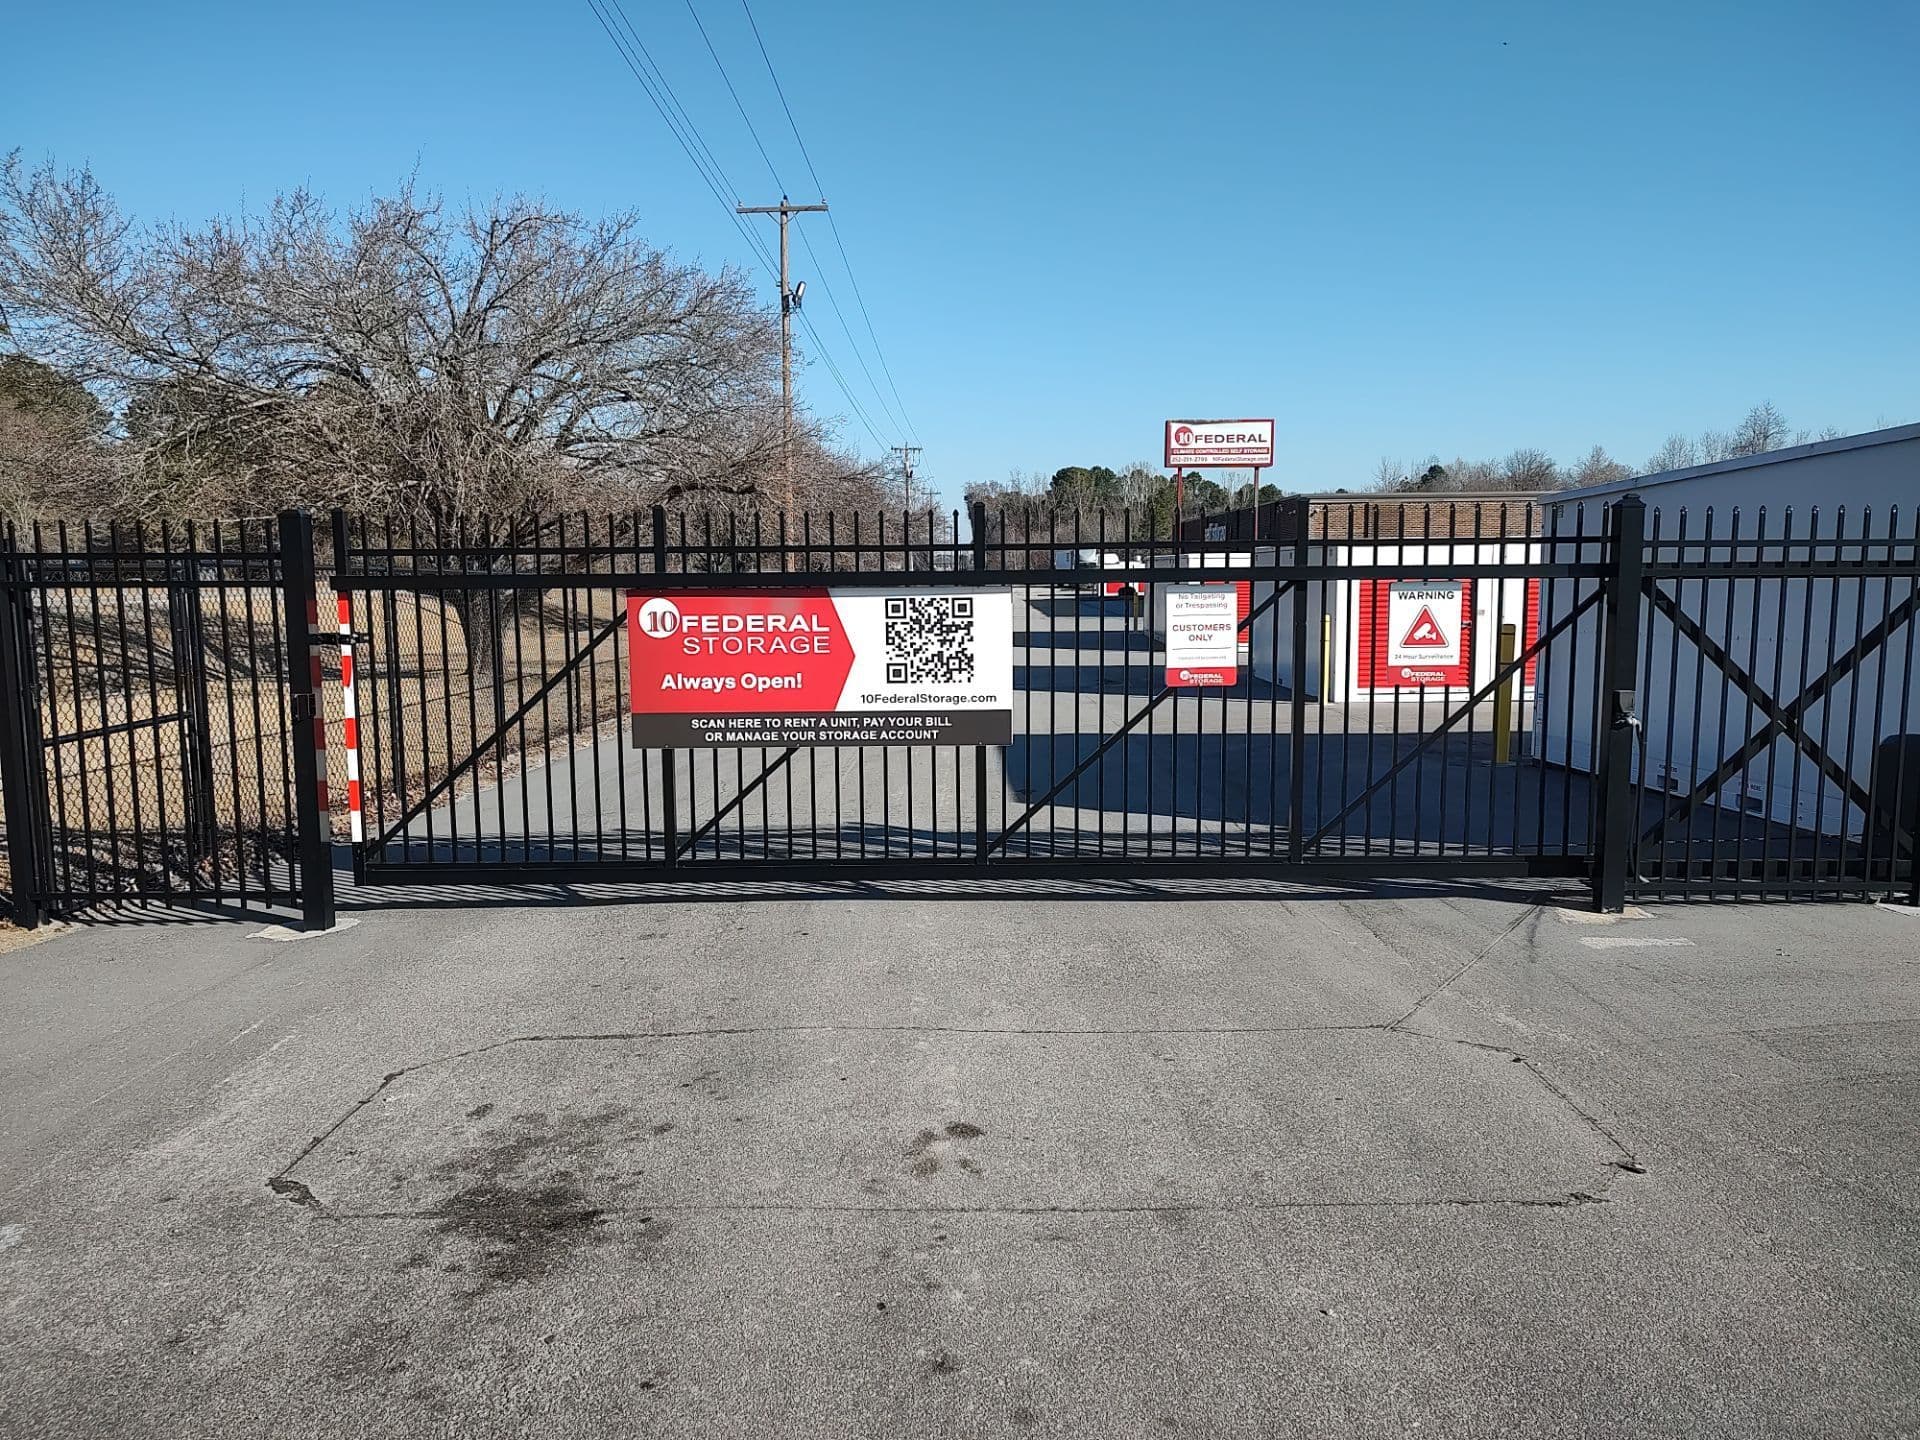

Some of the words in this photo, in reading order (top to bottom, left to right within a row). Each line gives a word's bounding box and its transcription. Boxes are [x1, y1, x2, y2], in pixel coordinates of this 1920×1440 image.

[1178, 432, 1193, 444] 10
[1195, 434, 1267, 443] FEDERAL
[1398, 591, 1455, 600] WARNING
[647, 611, 677, 632] 10
[681, 614, 830, 633] FEDERAL
[1172, 624, 1232, 632] CUSTOMERS
[1188, 634, 1213, 642] ONLY
[682, 636, 831, 655] STORAGE
[660, 673, 736, 693] Always
[740, 673, 802, 692] Open!
[860, 693, 997, 705] 10FederalStorage.com
[691, 719, 725, 729] SCAN
[728, 718, 761, 729] HERE
[765, 718, 781, 728] TO
[784, 718, 816, 728] RENT
[818, 718, 828, 727] A
[830, 717, 860, 729] UNIT,
[863, 717, 886, 727] PAY
[888, 717, 923, 727] YOUR
[925, 716, 952, 727] BILL
[705, 732, 723, 742] OR
[726, 731, 779, 741] MANAGE
[781, 731, 816, 741] YOUR
[819, 731, 877, 740] STORAGE
[879, 730, 939, 740] ACCOUNT
